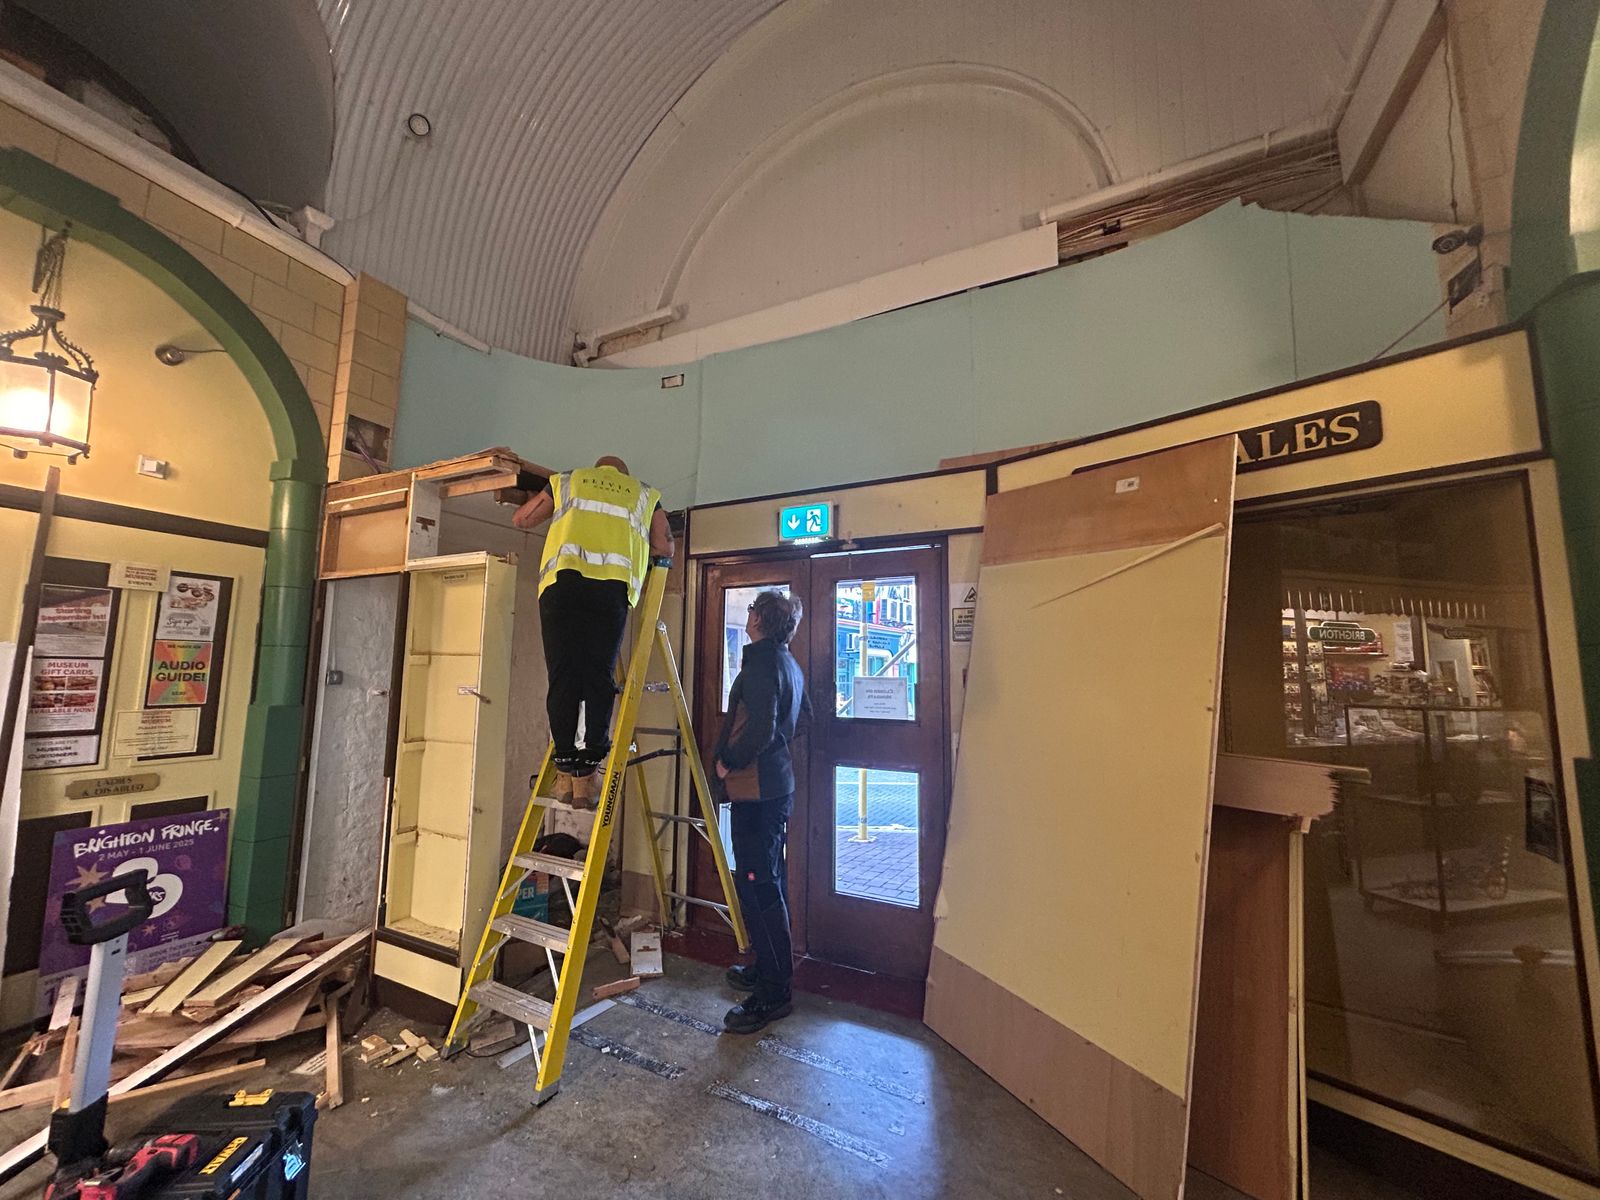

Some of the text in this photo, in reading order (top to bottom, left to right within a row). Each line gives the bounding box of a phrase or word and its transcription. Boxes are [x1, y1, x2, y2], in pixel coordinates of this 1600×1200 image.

[47, 661, 89, 669] MUSEUM
[158, 660, 206, 671] AUDIO
[41, 668, 94, 676] GIFT CARDS
[155, 672, 206, 682] GUIDE!
[27, 751, 79, 760] CUSTOMERS
[94, 784, 144, 795] DISABLED
[602, 771, 619, 828] YOUNGMAN
[73, 829, 154, 858] BRIGHTON
[99, 853, 105, 861] 2
[107, 849, 129, 860] MAY
[147, 843, 172, 854] JUNE
[173, 838, 195, 849] 2025
